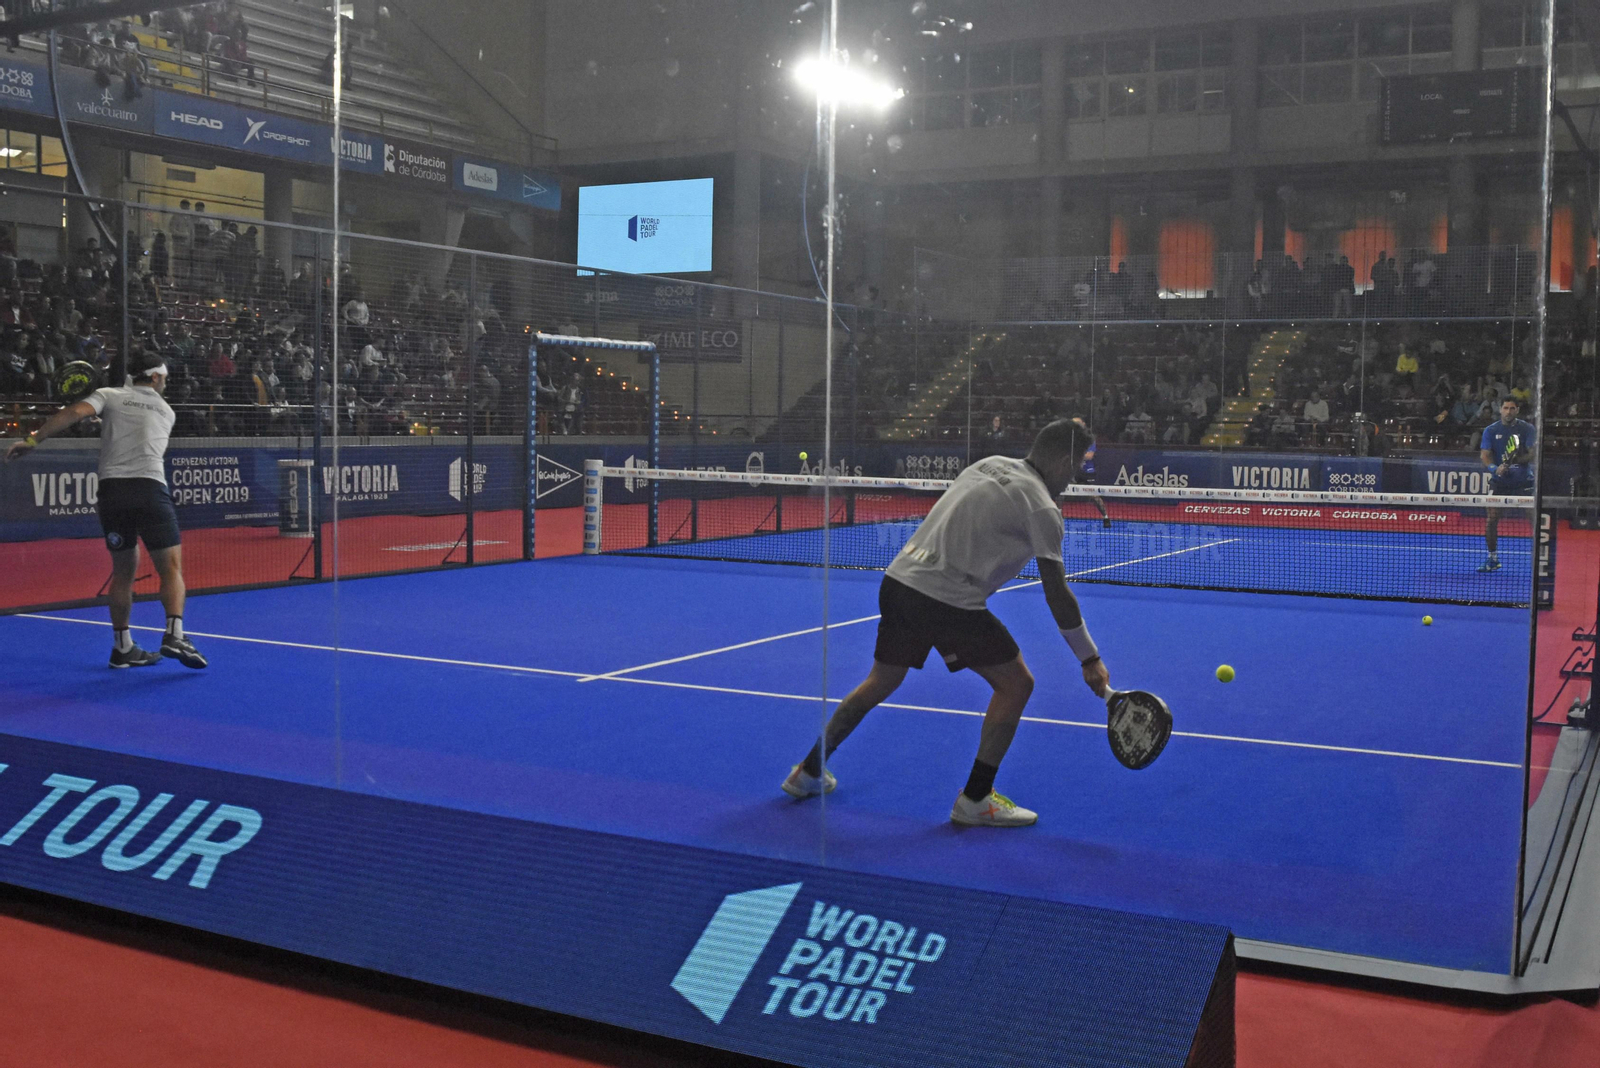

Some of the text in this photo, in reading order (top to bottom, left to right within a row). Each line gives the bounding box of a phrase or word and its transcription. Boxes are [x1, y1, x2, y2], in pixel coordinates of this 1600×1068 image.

[77, 101, 137, 122] valecuatro
[171, 111, 222, 130] HEAD
[263, 131, 309, 147] DROP SHOT
[331, 137, 372, 160] VCTORIA
[399, 150, 446, 170] Diputación
[399, 165, 446, 182] de Córdoba
[468, 170, 493, 185] Adeslas
[640, 217, 660, 225] WORLD
[640, 224, 658, 232] PADEL
[640, 231, 656, 239] TOUR
[172, 456, 239, 466] CERVEZAS VICTORIA
[172, 466, 242, 485] CÓRDOBA
[323, 464, 399, 494] VICTORIA
[1114, 464, 1188, 488] Adeslas
[1232, 466, 1310, 489] VICTORIA
[1427, 470, 1492, 495] VICTOR
[32, 472, 98, 507] VICTO
[172, 486, 249, 506] OPEN 2019
[288, 469, 299, 529] HEAD
[1184, 505, 1447, 523] CERVEZAS VICTORIA CÓRDOBA OPEN
[0, 773, 263, 889] TOUR
[806, 900, 947, 963] WORLD
[778, 937, 916, 994] PADEL
[762, 976, 887, 1024] TOUR
